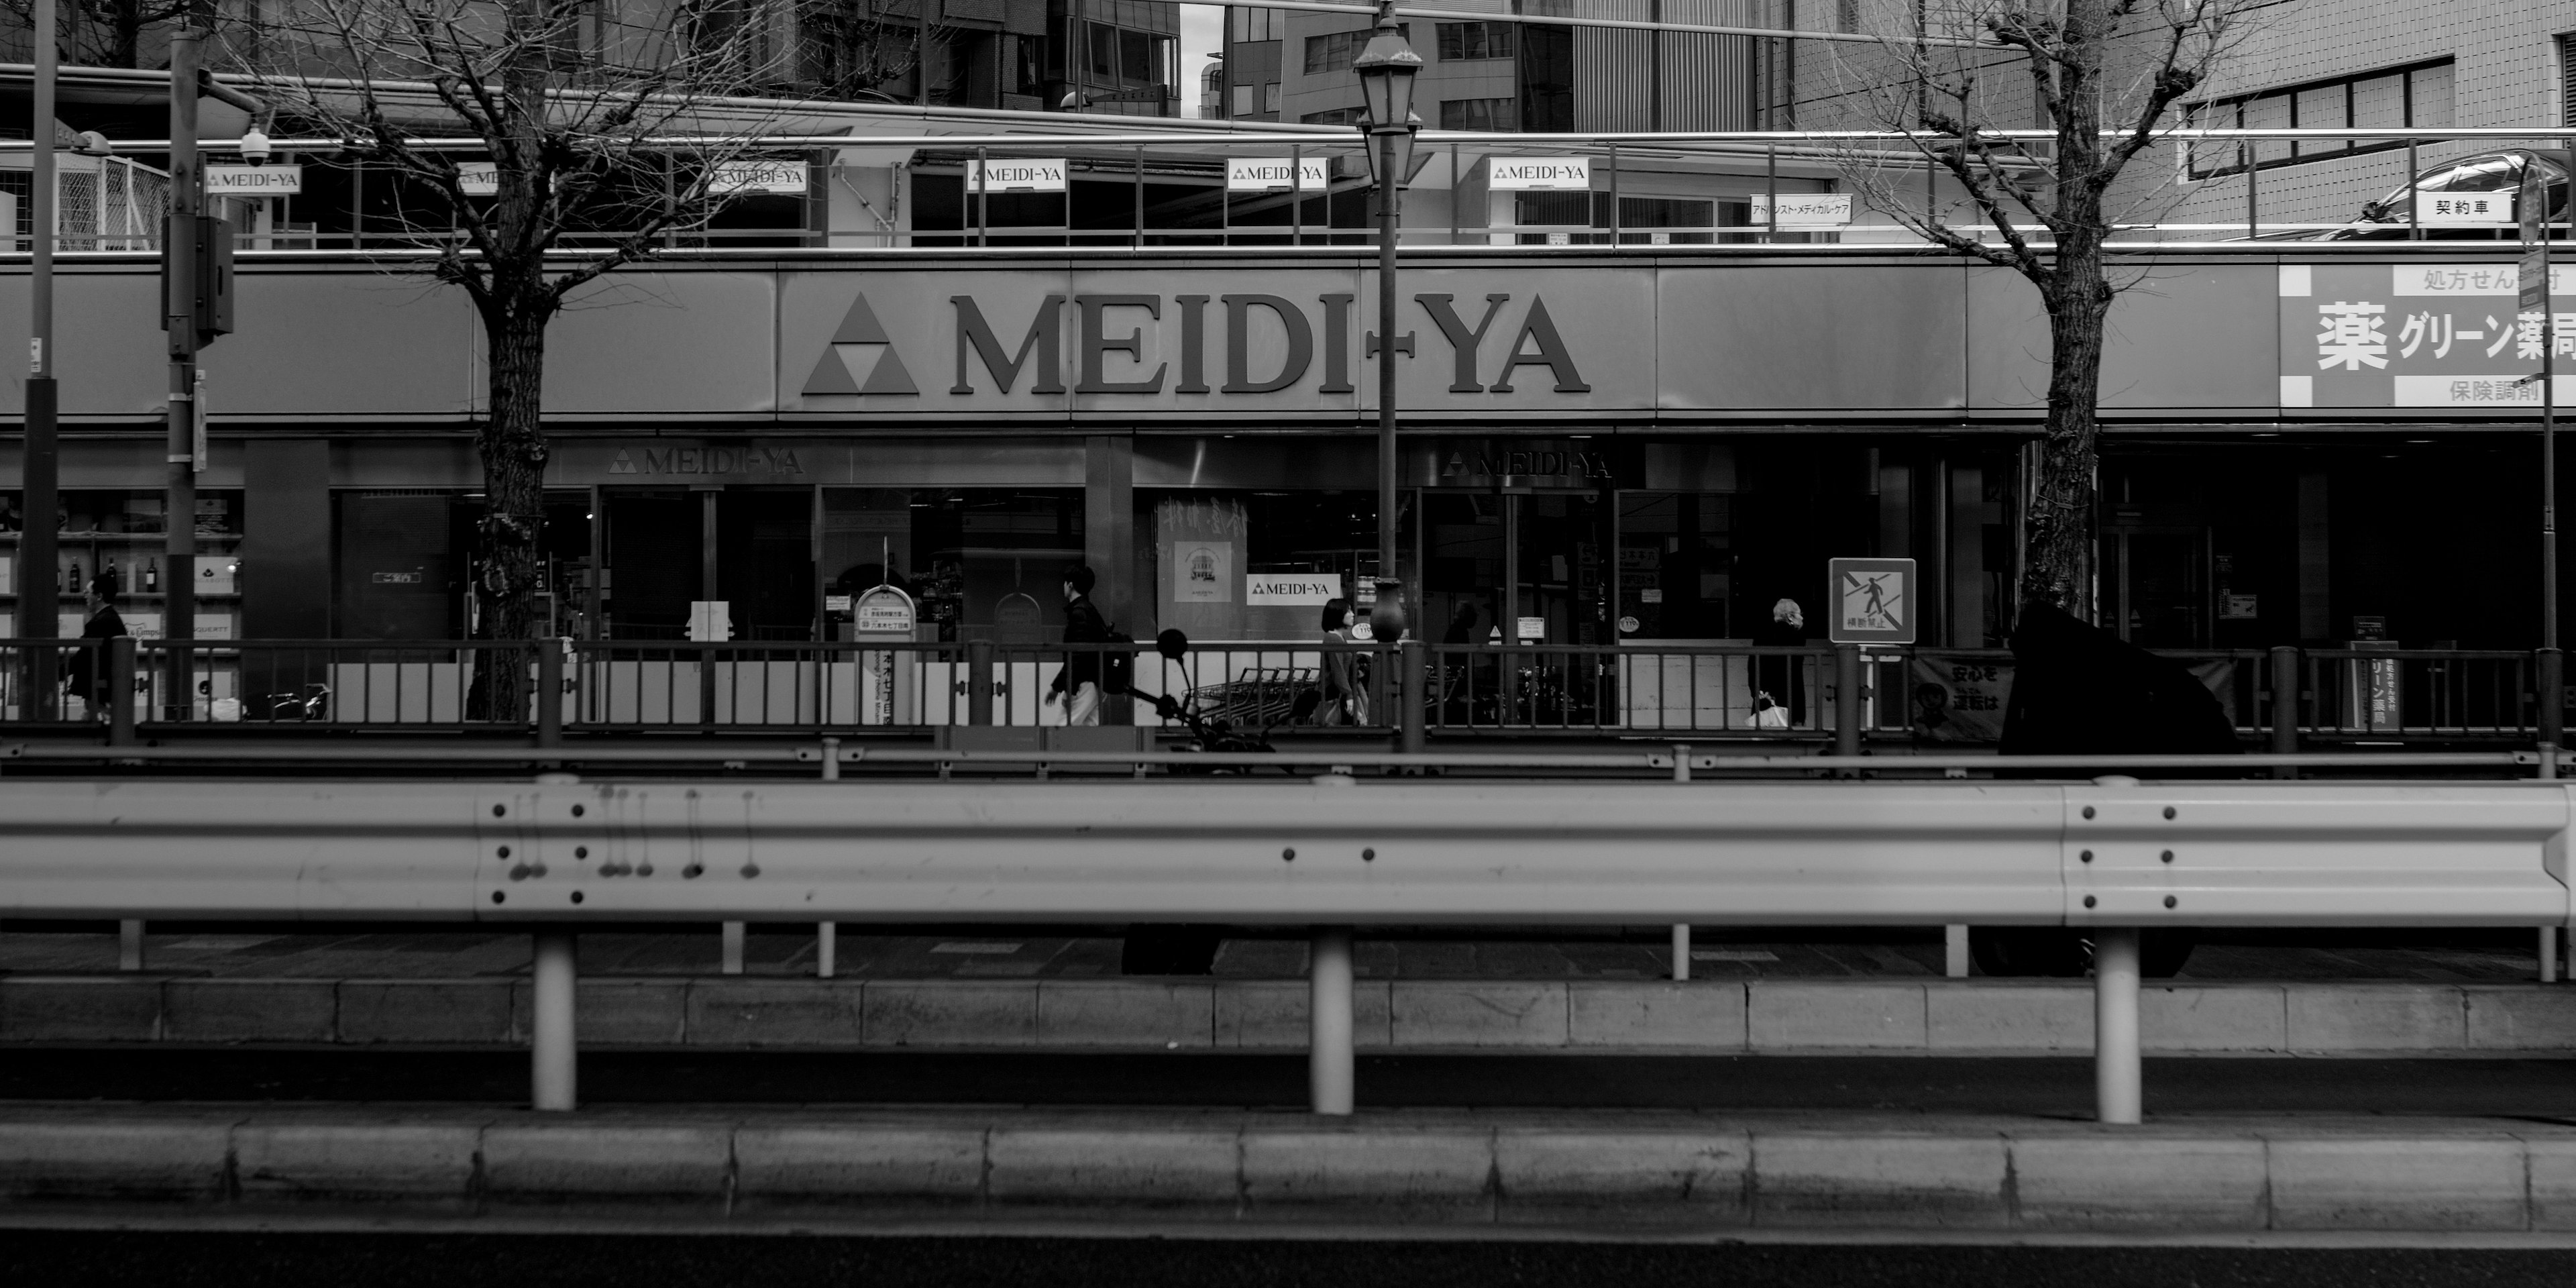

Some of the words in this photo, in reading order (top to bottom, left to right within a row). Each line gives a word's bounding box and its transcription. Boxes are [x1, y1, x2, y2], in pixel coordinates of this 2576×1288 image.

[223, 174, 297, 186] MEIDI-YA
[729, 170, 803, 183] MEIDI-YA
[987, 168, 1061, 181] MEIDI-YA
[1509, 166, 1585, 179] MEIDI-YA
[2436, 200, 2489, 215] 契約車
[2424, 270, 2561, 290] 処方せん付
[2316, 301, 2390, 370] 薬
[2398, 311, 2576, 360] グリーン薬局
[950, 294, 1591, 394] MEIDI-YA
[2450, 380, 2539, 401] 保険調剤
[645, 448, 804, 474] MEIDI-YA
[1477, 451, 1613, 478] MEIDI-YA
[1267, 582, 1330, 595] MEIDI-YA
[1847, 617, 1886, 629] 横断禁止
[1953, 666, 1997, 682] 安心を
[2372, 659, 2385, 724] リーン薬局
[1953, 696, 1998, 710] 運転は
